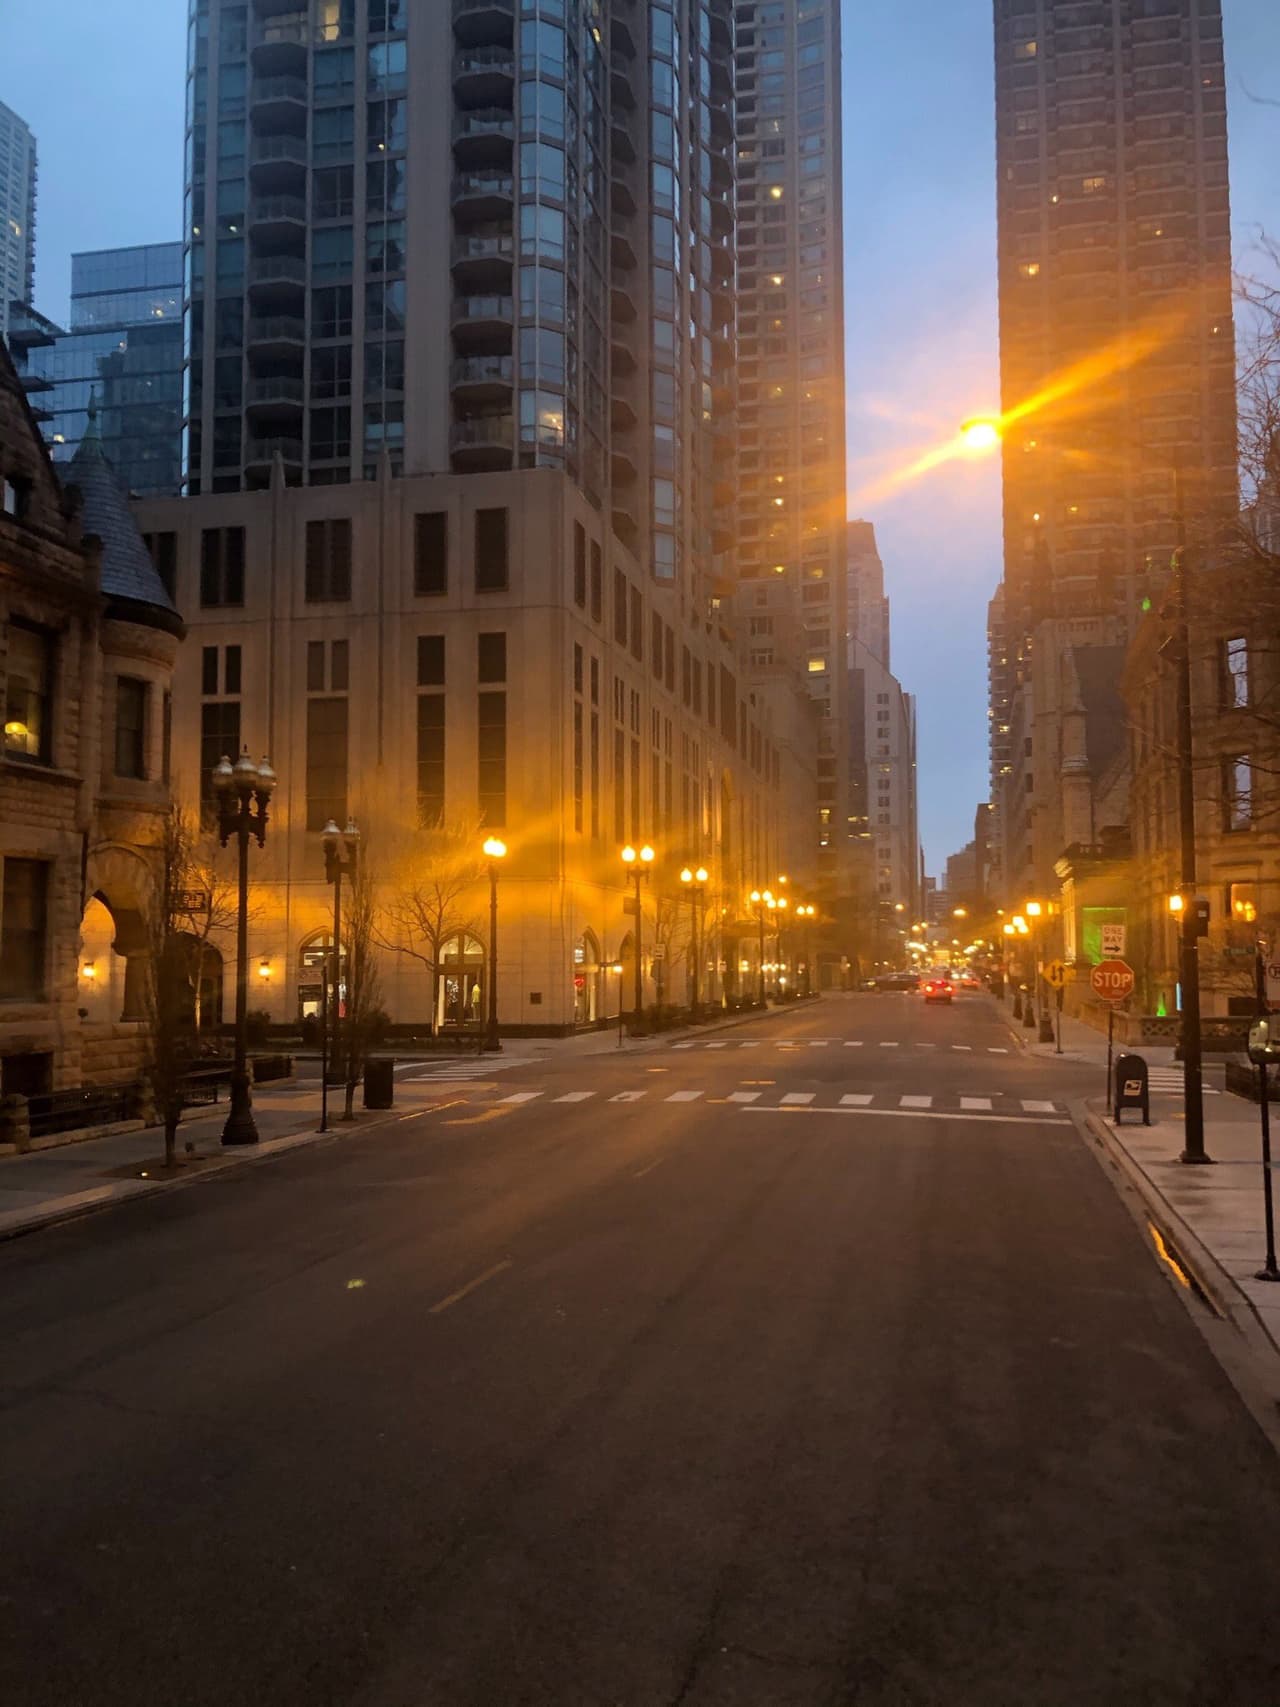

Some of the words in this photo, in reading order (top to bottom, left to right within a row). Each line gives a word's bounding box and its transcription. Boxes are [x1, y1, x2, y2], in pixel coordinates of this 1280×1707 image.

[1104, 927, 1121, 935] ONE
[1104, 935, 1122, 943] WAY
[1094, 972, 1131, 988] STOP
